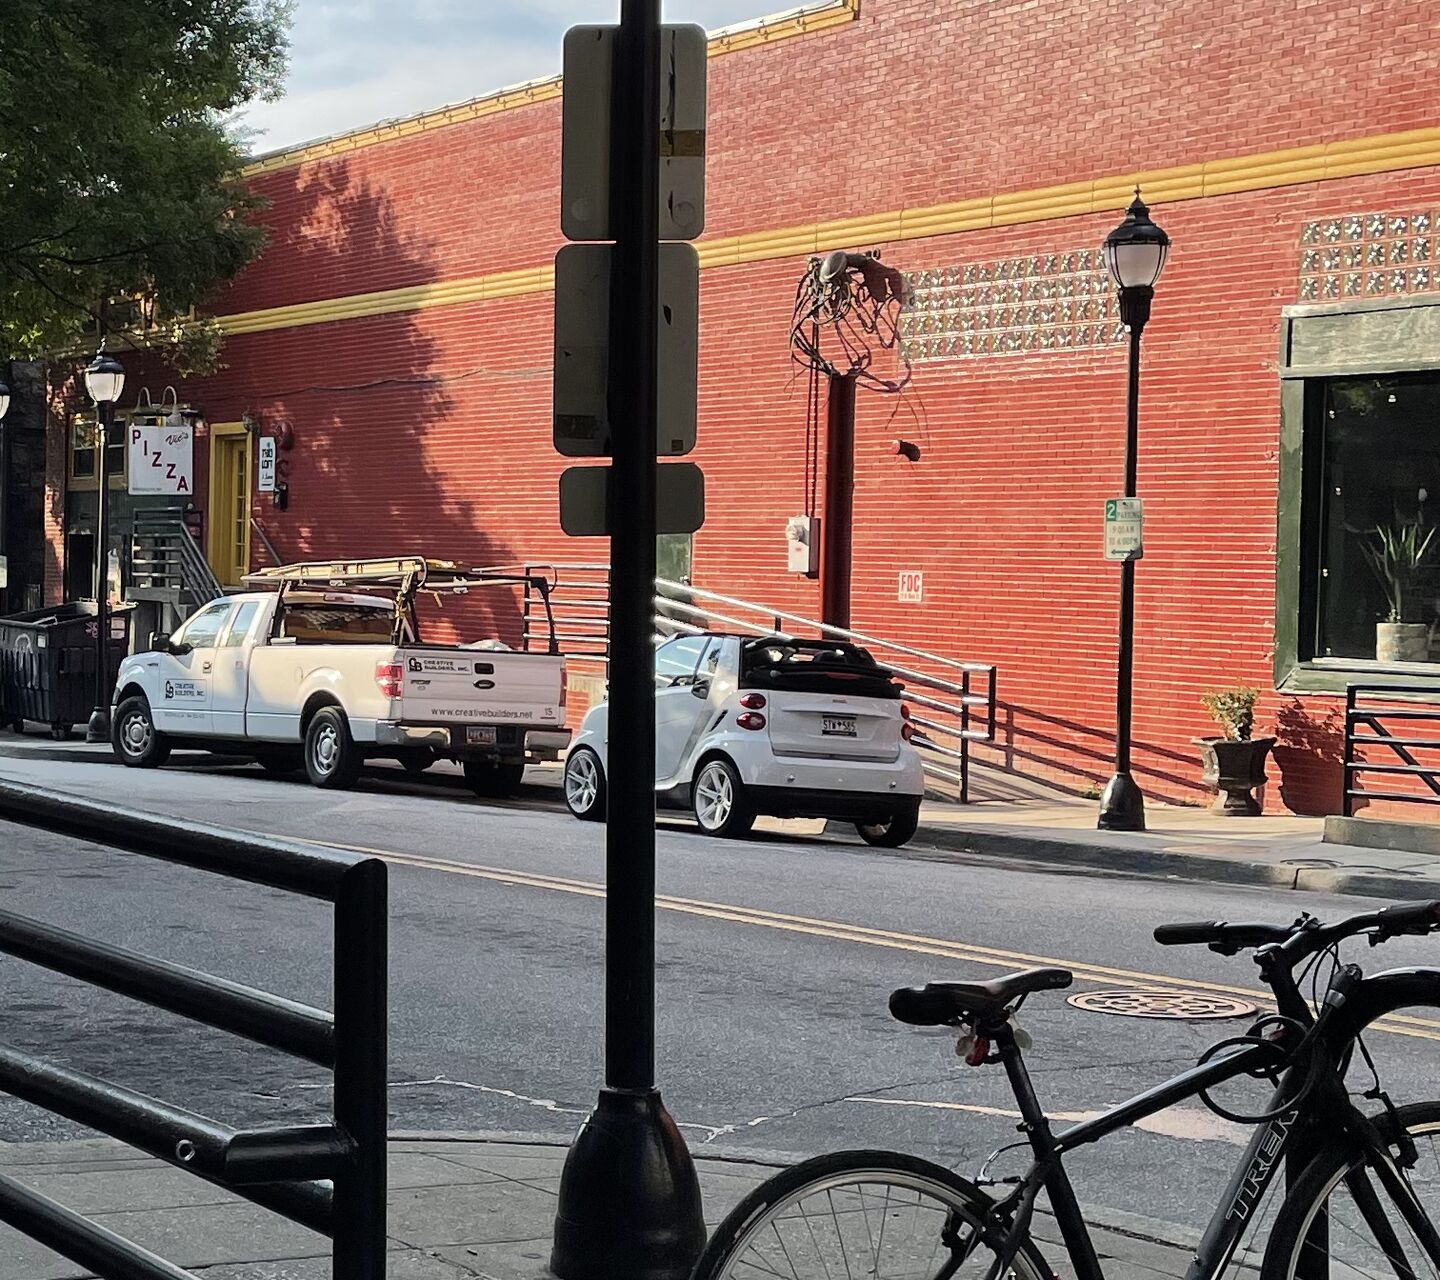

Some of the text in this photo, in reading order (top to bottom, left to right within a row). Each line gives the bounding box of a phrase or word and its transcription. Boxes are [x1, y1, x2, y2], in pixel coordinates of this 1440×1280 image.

[132, 429, 189, 492] PIZZA
[1107, 503, 1116, 519] 2
[901, 574, 920, 592] FDC
[431, 706, 534, 720] www.creativebuilders.net
[1225, 1110, 1299, 1220] TREK
